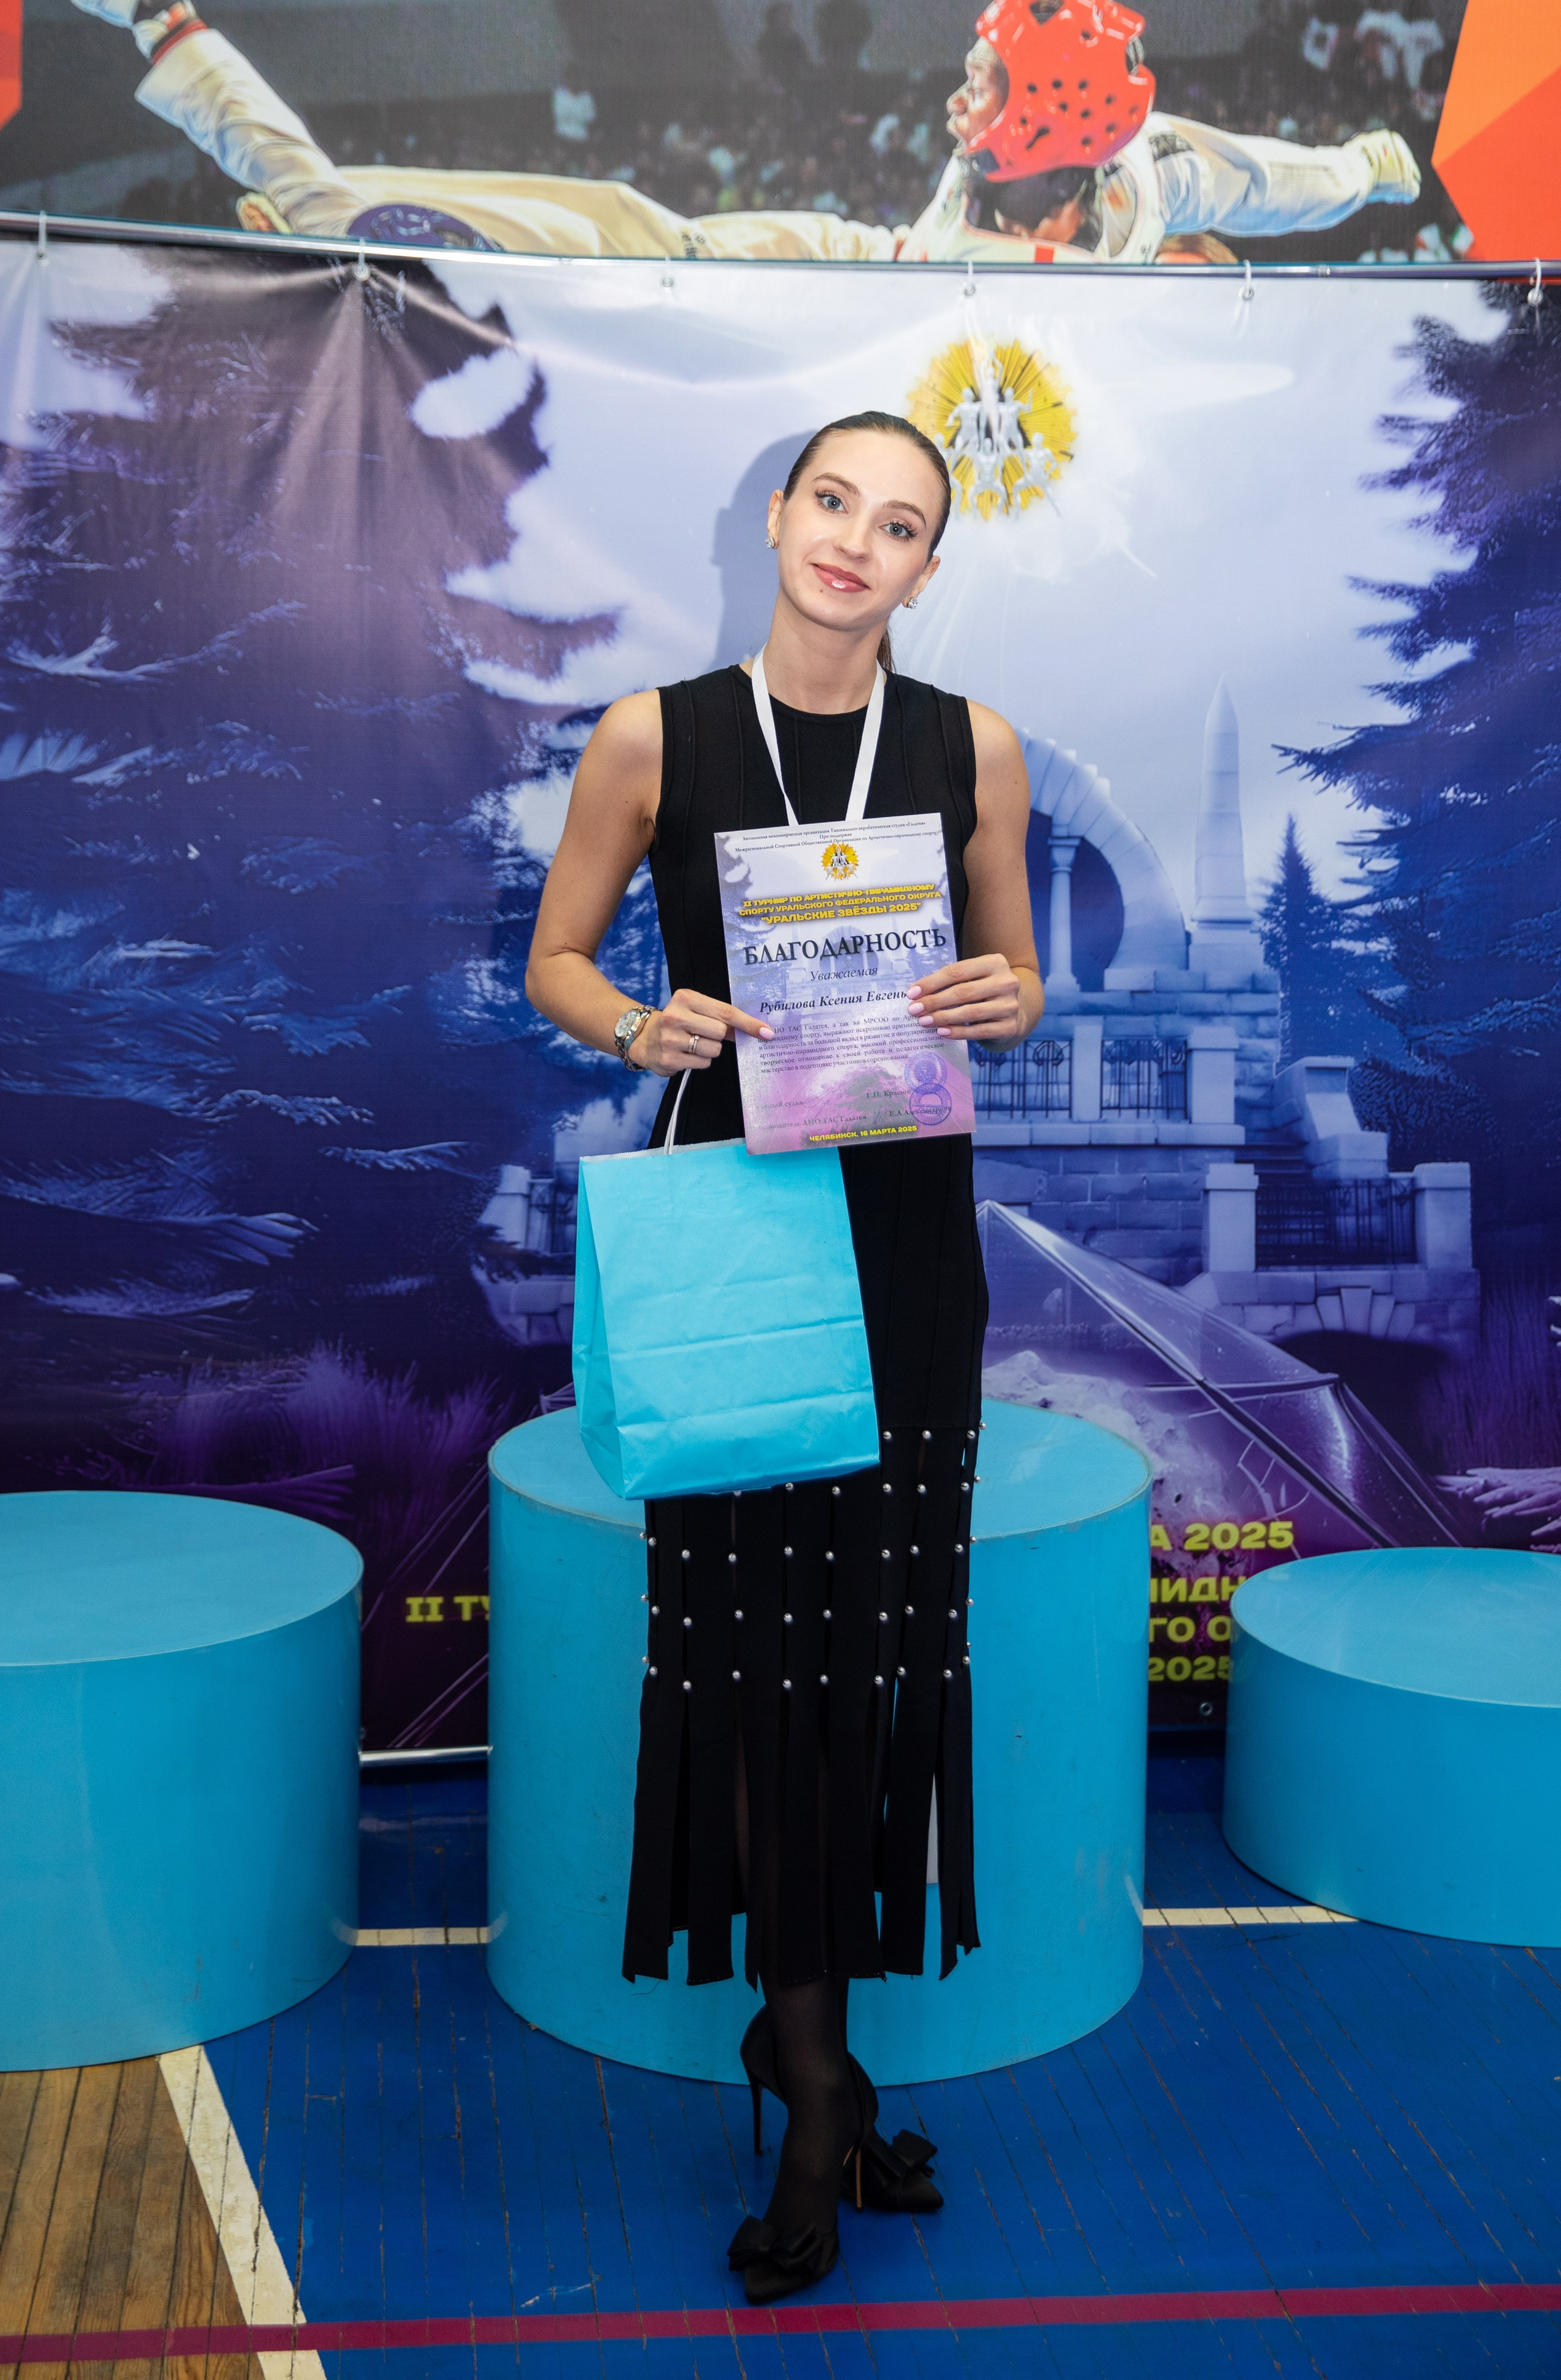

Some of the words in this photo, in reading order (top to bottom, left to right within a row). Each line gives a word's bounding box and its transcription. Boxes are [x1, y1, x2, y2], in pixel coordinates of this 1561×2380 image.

[830, 824, 890, 833] Танцевально-акробатическая
[868, 832, 922, 840] Артистично-пирамидному
[803, 883, 935, 900] АРТИСТИЧНО-ПИРАМИДНОМУ
[775, 901, 834, 911] УРАЛЬСКОГО
[835, 894, 906, 906] ФЕДЕРАЛЬНОГО
[760, 911, 835, 924] "УРАЛЬСКИЕ
[837, 903, 887, 916] ЗВЁЗДЫ
[888, 902, 921, 911] 2025"
[742, 928, 946, 964] БЛАГОДАРНОСТЬ
[809, 966, 878, 980] Уважаемая
[759, 998, 815, 1013] Рубилова
[818, 993, 862, 1006] Ксения
[865, 988, 907, 1001] Евгень
[759, 1047, 834, 1057] артистично-пирамидного
[888, 1035, 943, 1045] профессионализм,
[763, 1041, 806, 1050] благодарность
[866, 1054, 909, 1063] соревнований.
[884, 1088, 912, 1097] Красюк
[839, 1113, 866, 1122] Галатея
[809, 1131, 859, 1141] ЧЕЛЯБИНСК,
[1151, 1524, 1173, 1551] А
[1184, 1521, 1294, 1550] 2025
[1150, 1576, 1246, 1603] ИДН
[405, 1597, 444, 1622] II
[1149, 1616, 1196, 1643] ГО
[1207, 1615, 1231, 1642] О
